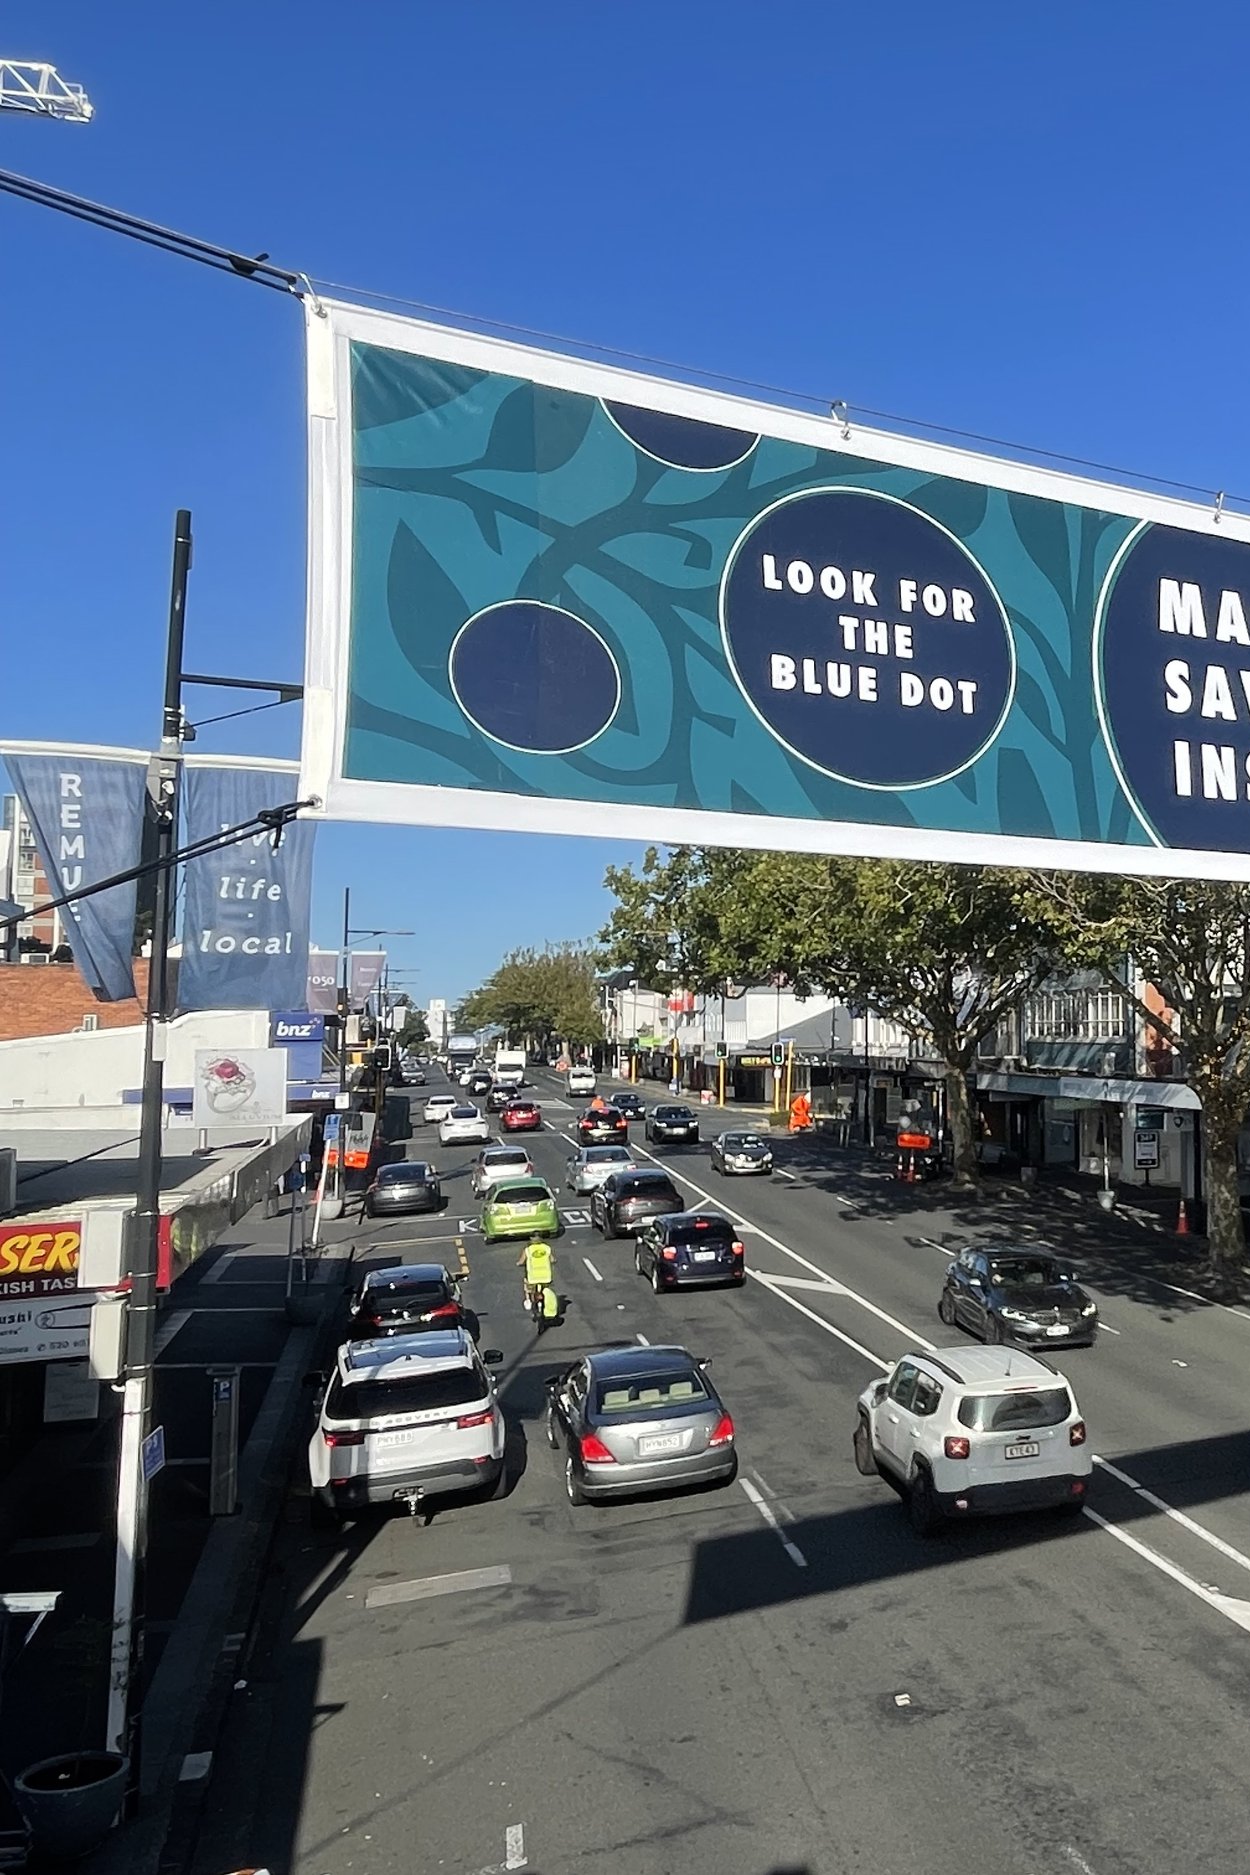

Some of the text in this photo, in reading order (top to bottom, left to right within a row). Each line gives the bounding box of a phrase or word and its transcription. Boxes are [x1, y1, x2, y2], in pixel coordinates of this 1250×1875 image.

[763, 554, 976, 623] LOOK FOR
[838, 615, 914, 659] THE
[771, 653, 977, 714] BLUE DOT
[219, 876, 281, 901] life
[200, 929, 292, 954] local
[276, 1020, 313, 1037] bnz
[311, 1090, 331, 1099] bnz
[0, 1231, 80, 1275] SER
[0, 1281, 35, 1294] ISH
